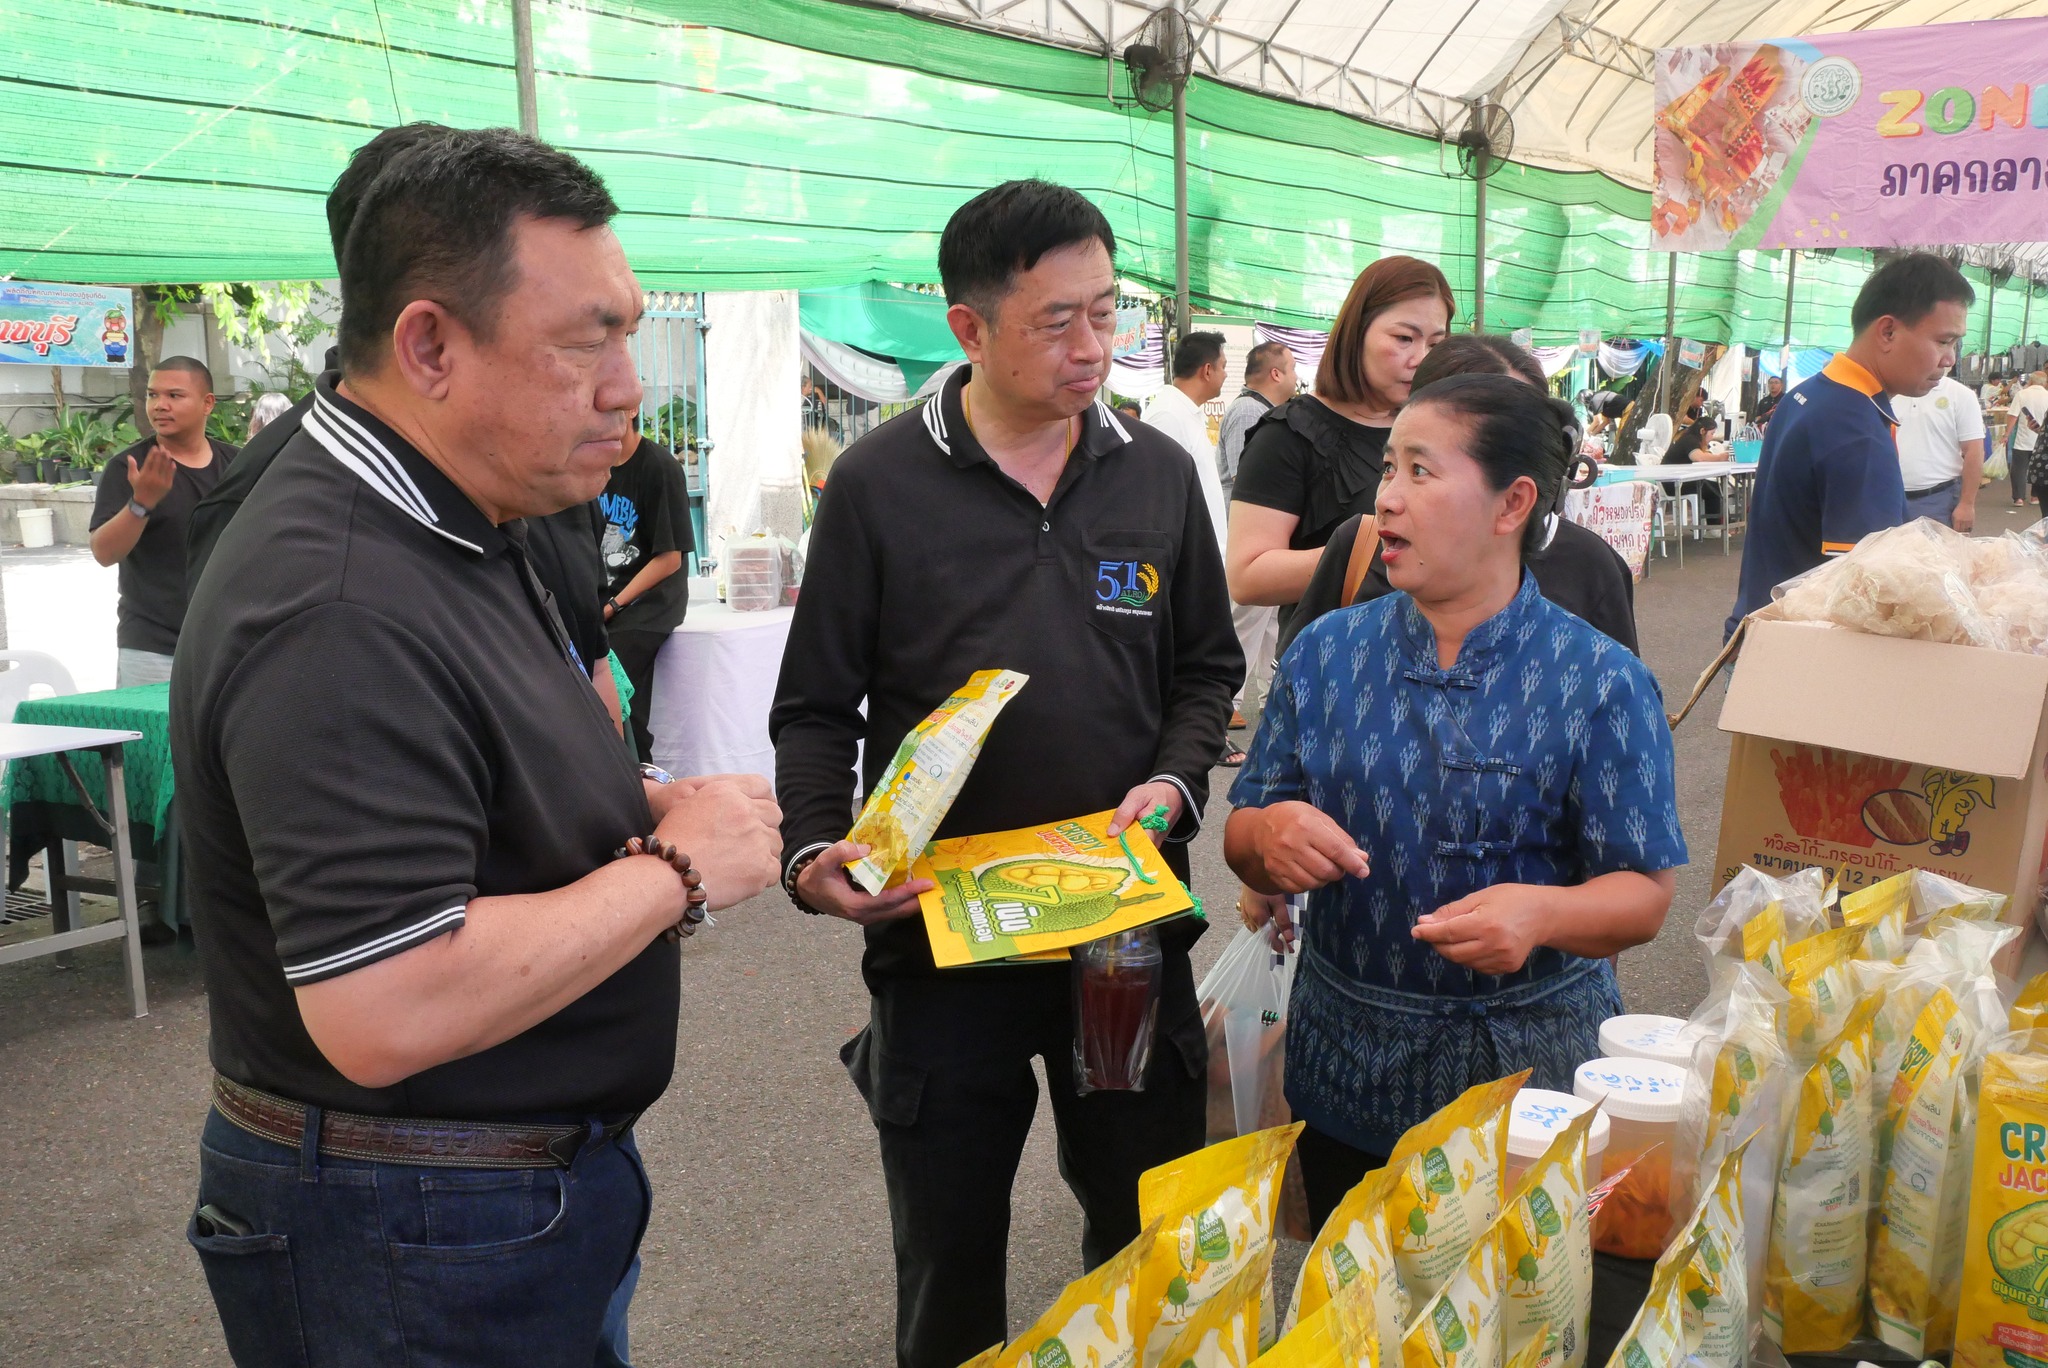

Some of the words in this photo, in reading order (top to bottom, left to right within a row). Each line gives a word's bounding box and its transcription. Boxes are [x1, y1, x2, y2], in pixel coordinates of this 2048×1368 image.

[1880, 157, 2048, 197] ภาคกลา
[0, 315, 79, 356] าชบุรี
[1096, 561, 1140, 601] 51
[1036, 830, 1080, 856] JACKFRUIT
[1054, 821, 1107, 851] CRISPY
[1845, 869, 1864, 885] 12
[2001, 1121, 2048, 1164] CR
[1999, 1163, 2048, 1194] JAC
[1992, 1278, 2048, 1309] ขนุนทอง
